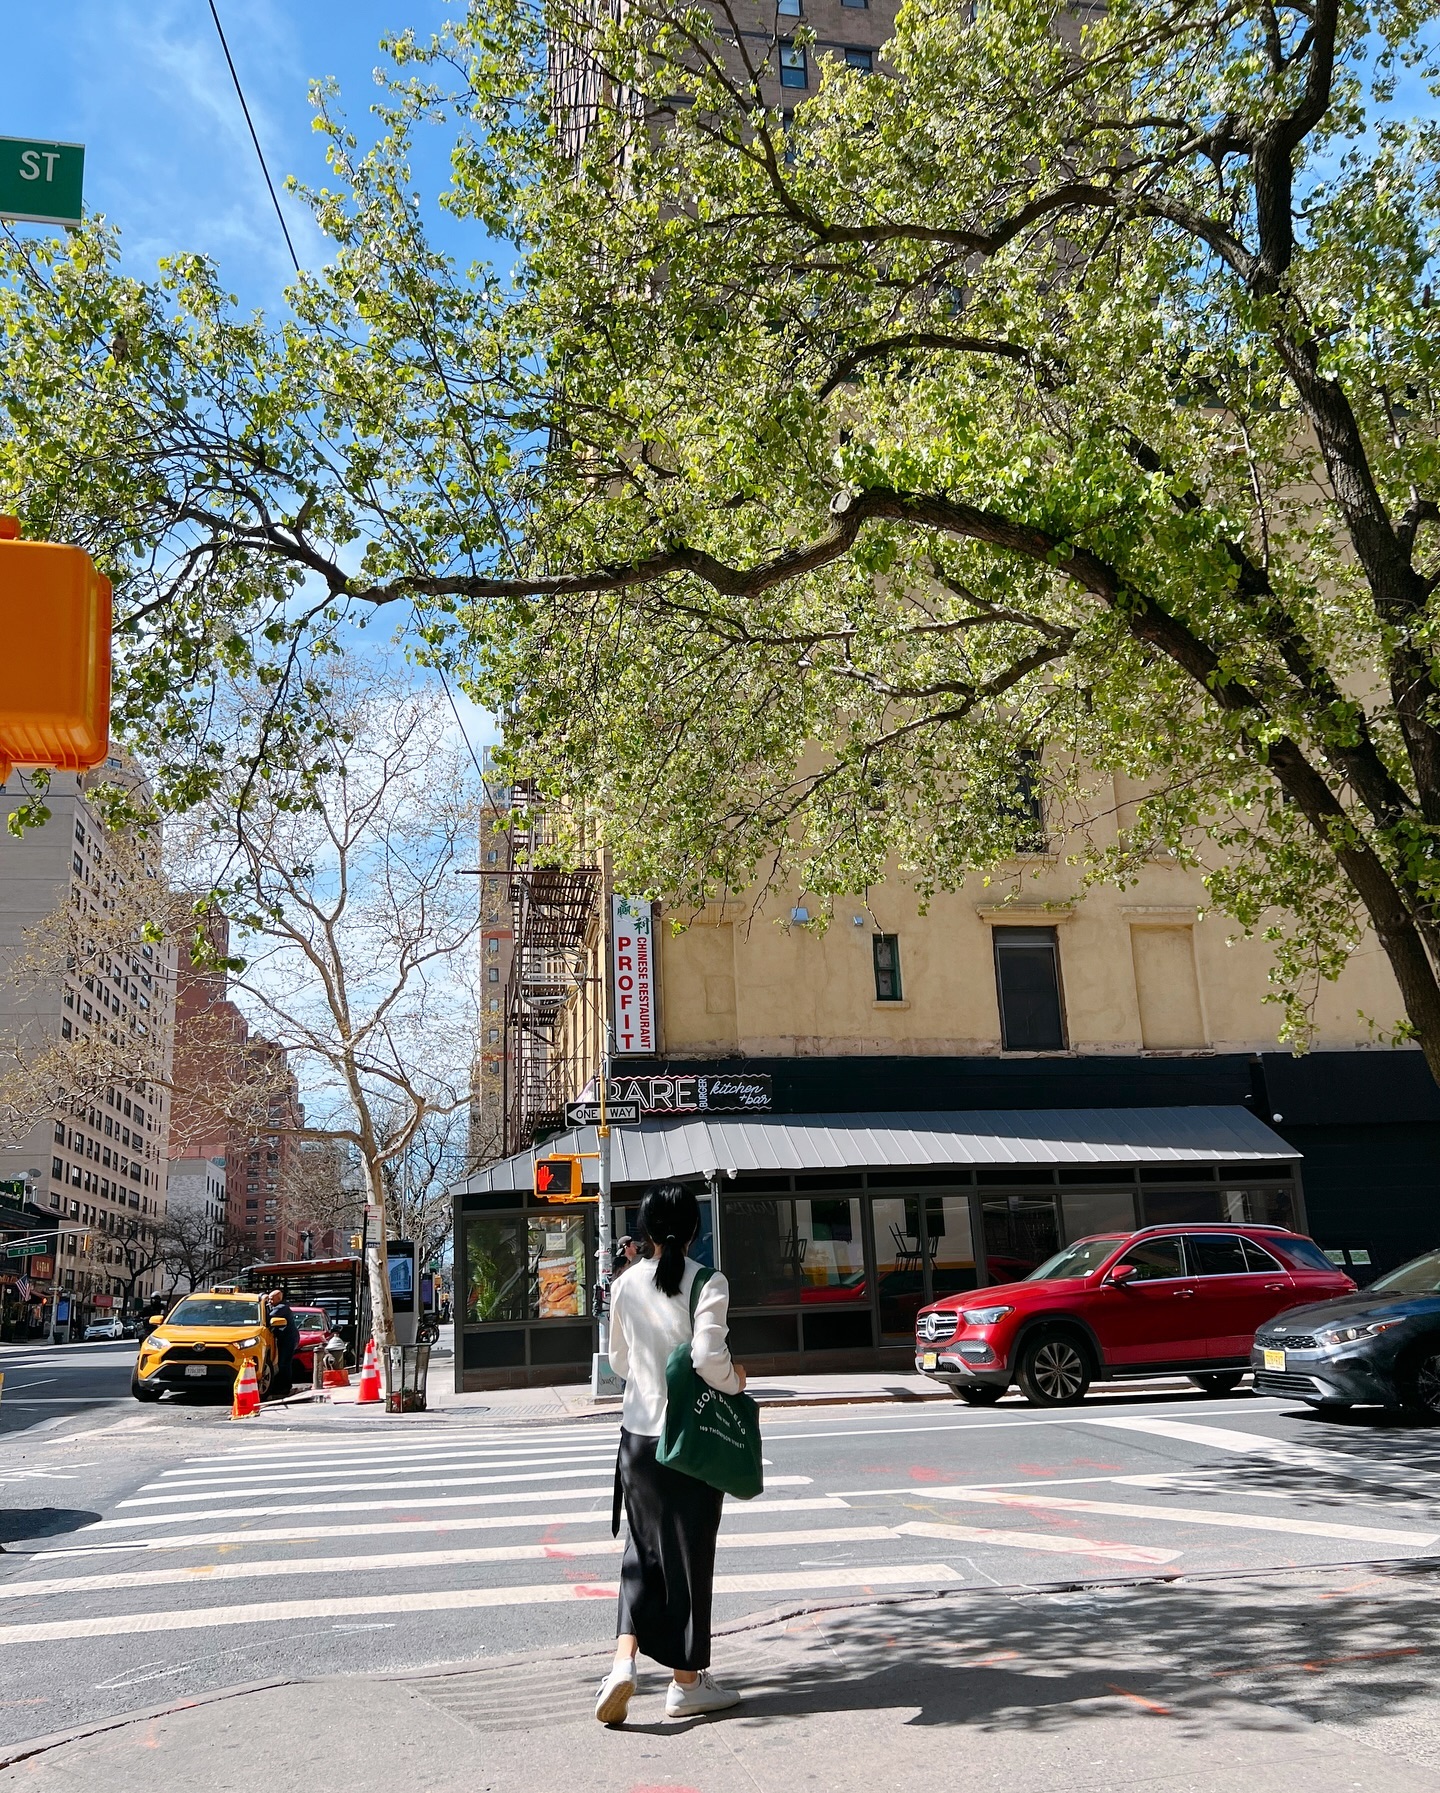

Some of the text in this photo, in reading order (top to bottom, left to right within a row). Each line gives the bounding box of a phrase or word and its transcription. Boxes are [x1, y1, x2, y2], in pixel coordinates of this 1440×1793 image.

[19, 150, 61, 182] ST
[618, 936, 635, 1050] PROFIT
[637, 937, 651, 1049] CHINESE RESTAURANT
[698, 1078, 709, 1108] BURGER
[709, 1081, 764, 1095] kitchen
[576, 1107, 633, 1119] ONE WAY
